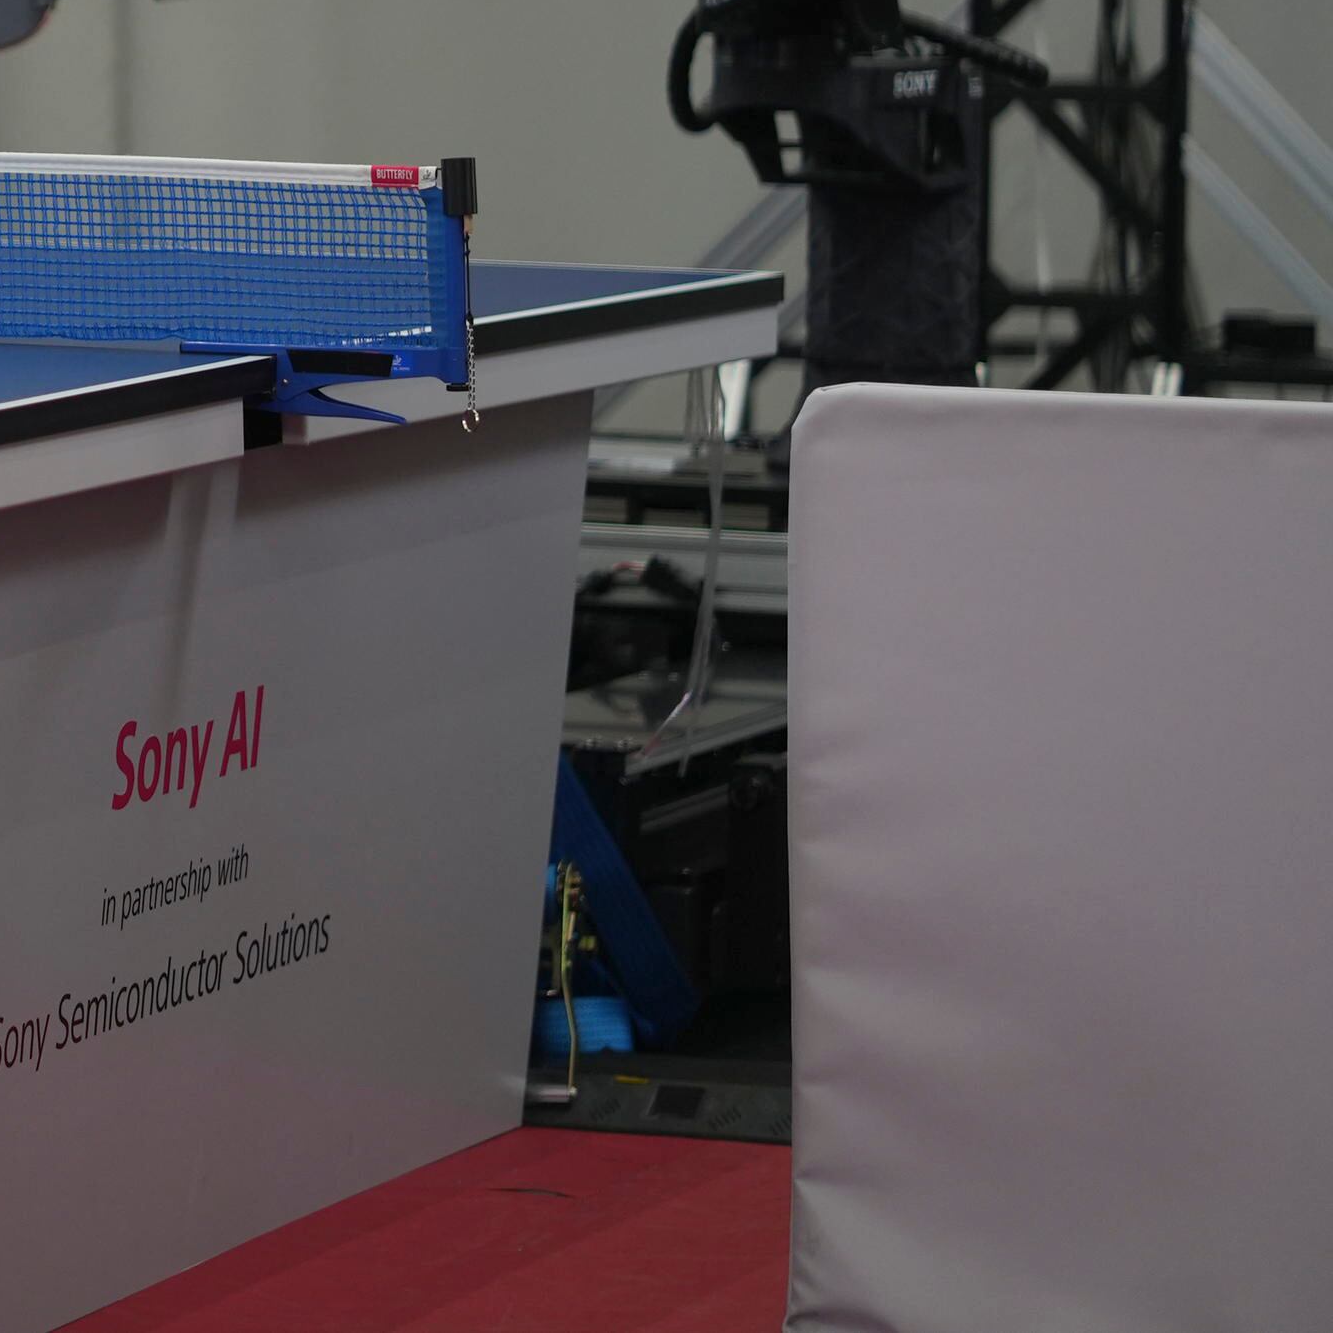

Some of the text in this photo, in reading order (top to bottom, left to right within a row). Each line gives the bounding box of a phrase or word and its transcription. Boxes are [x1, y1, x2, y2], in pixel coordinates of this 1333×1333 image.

[376, 168, 414, 181] BUTTERFLY
[111, 684, 265, 811] Sony AI
[101, 843, 250, 931] in partnership with
[55, 949, 228, 1050] Semiconductor
[232, 912, 331, 985] Solutions
